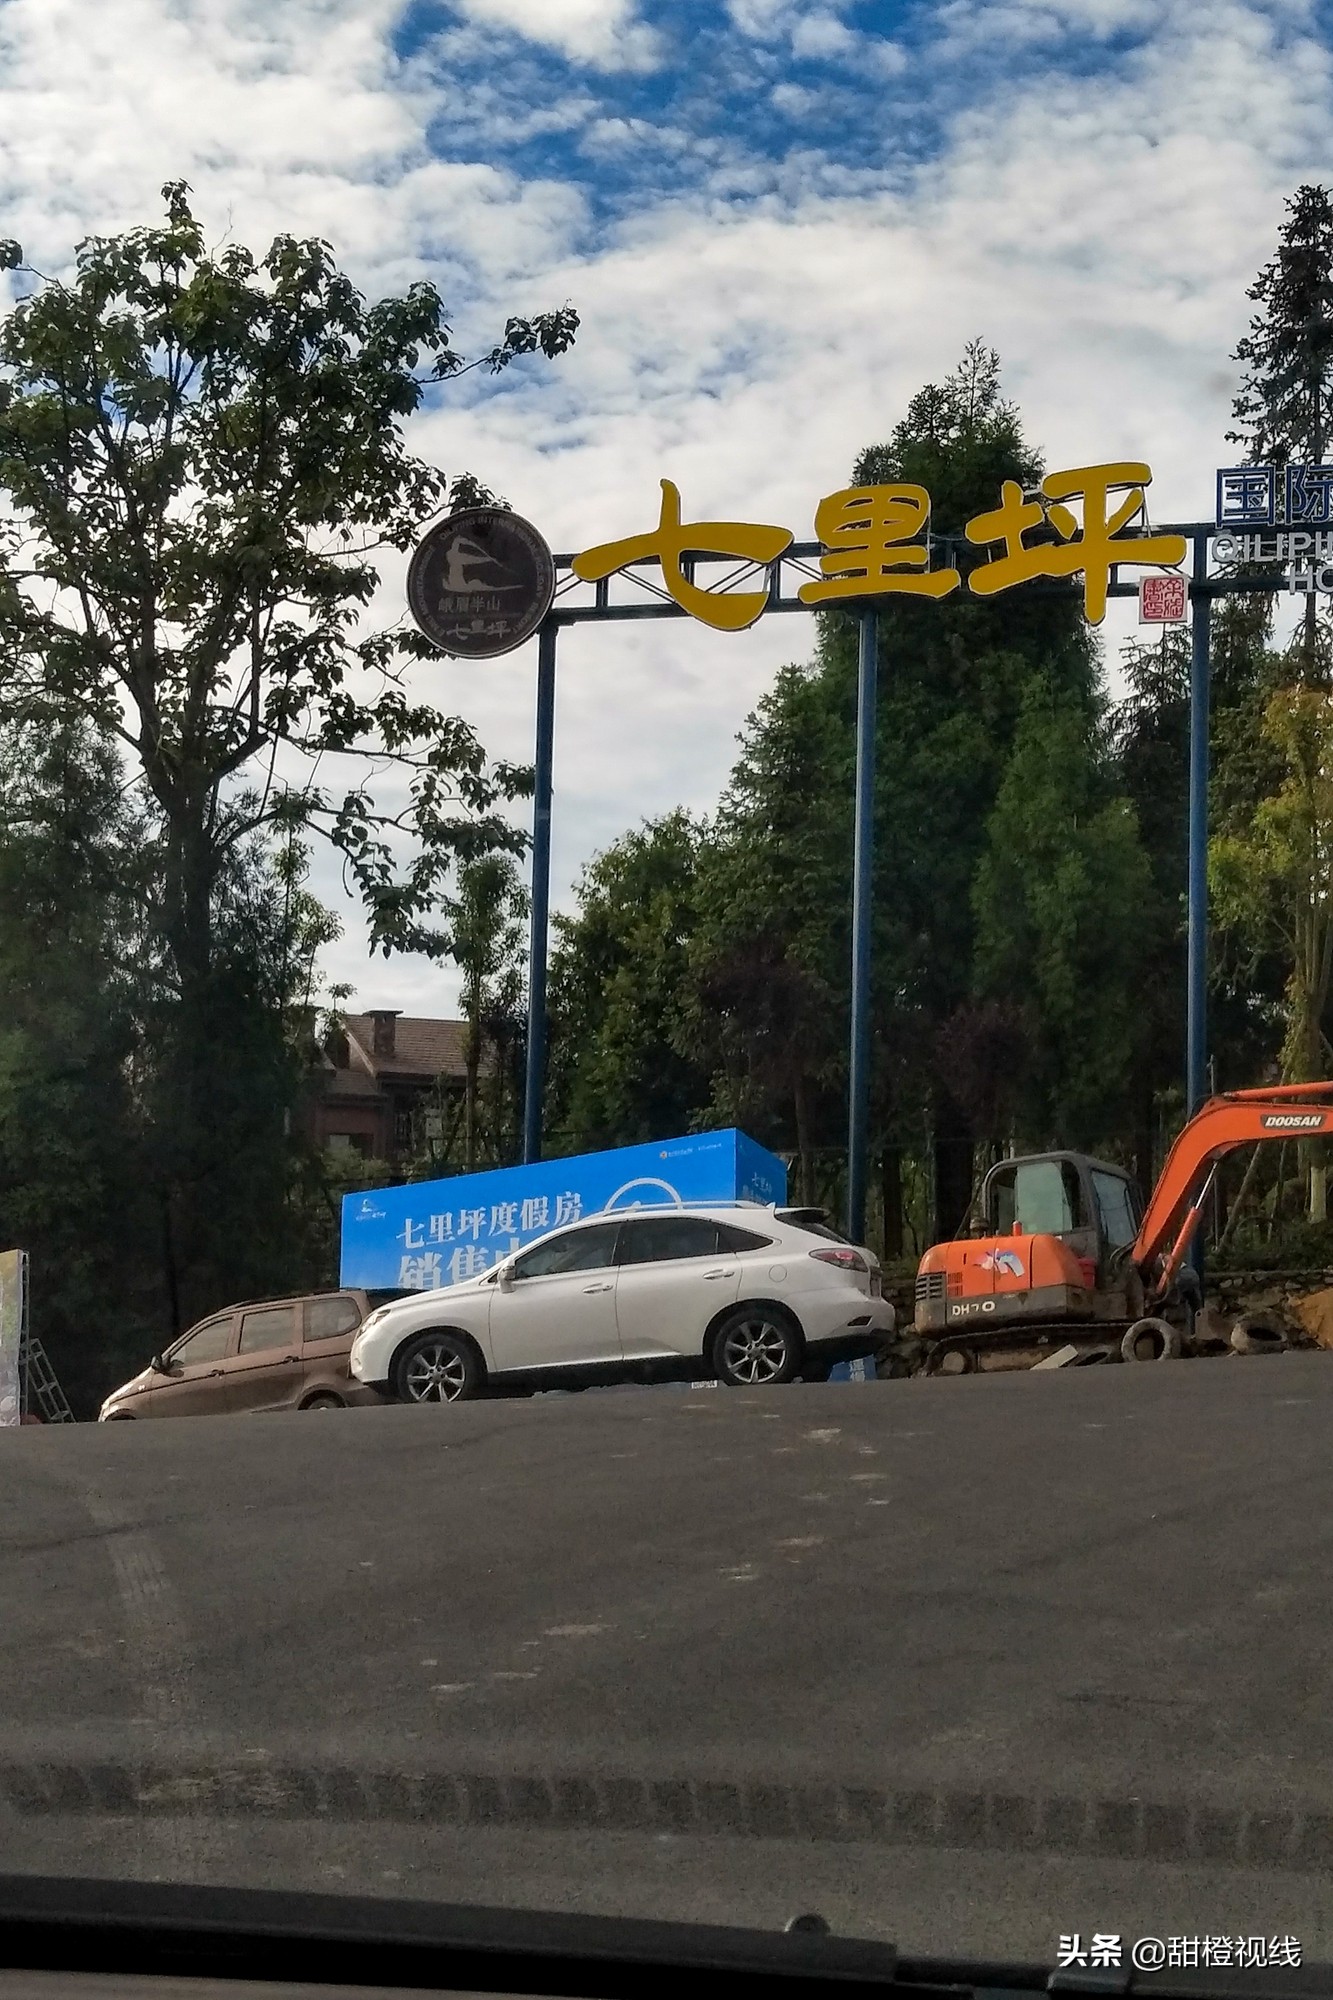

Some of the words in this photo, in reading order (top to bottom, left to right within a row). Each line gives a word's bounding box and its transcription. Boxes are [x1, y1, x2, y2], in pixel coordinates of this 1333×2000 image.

[1215, 465, 1333, 529] 国际
[571, 462, 1187, 632] 七里坪
[1212, 531, 1333, 563] QILIPI
[446, 618, 512, 641] 七里坪
[1265, 1115, 1322, 1127] DOOSAN
[396, 1191, 582, 1249] 七里坪度假房
